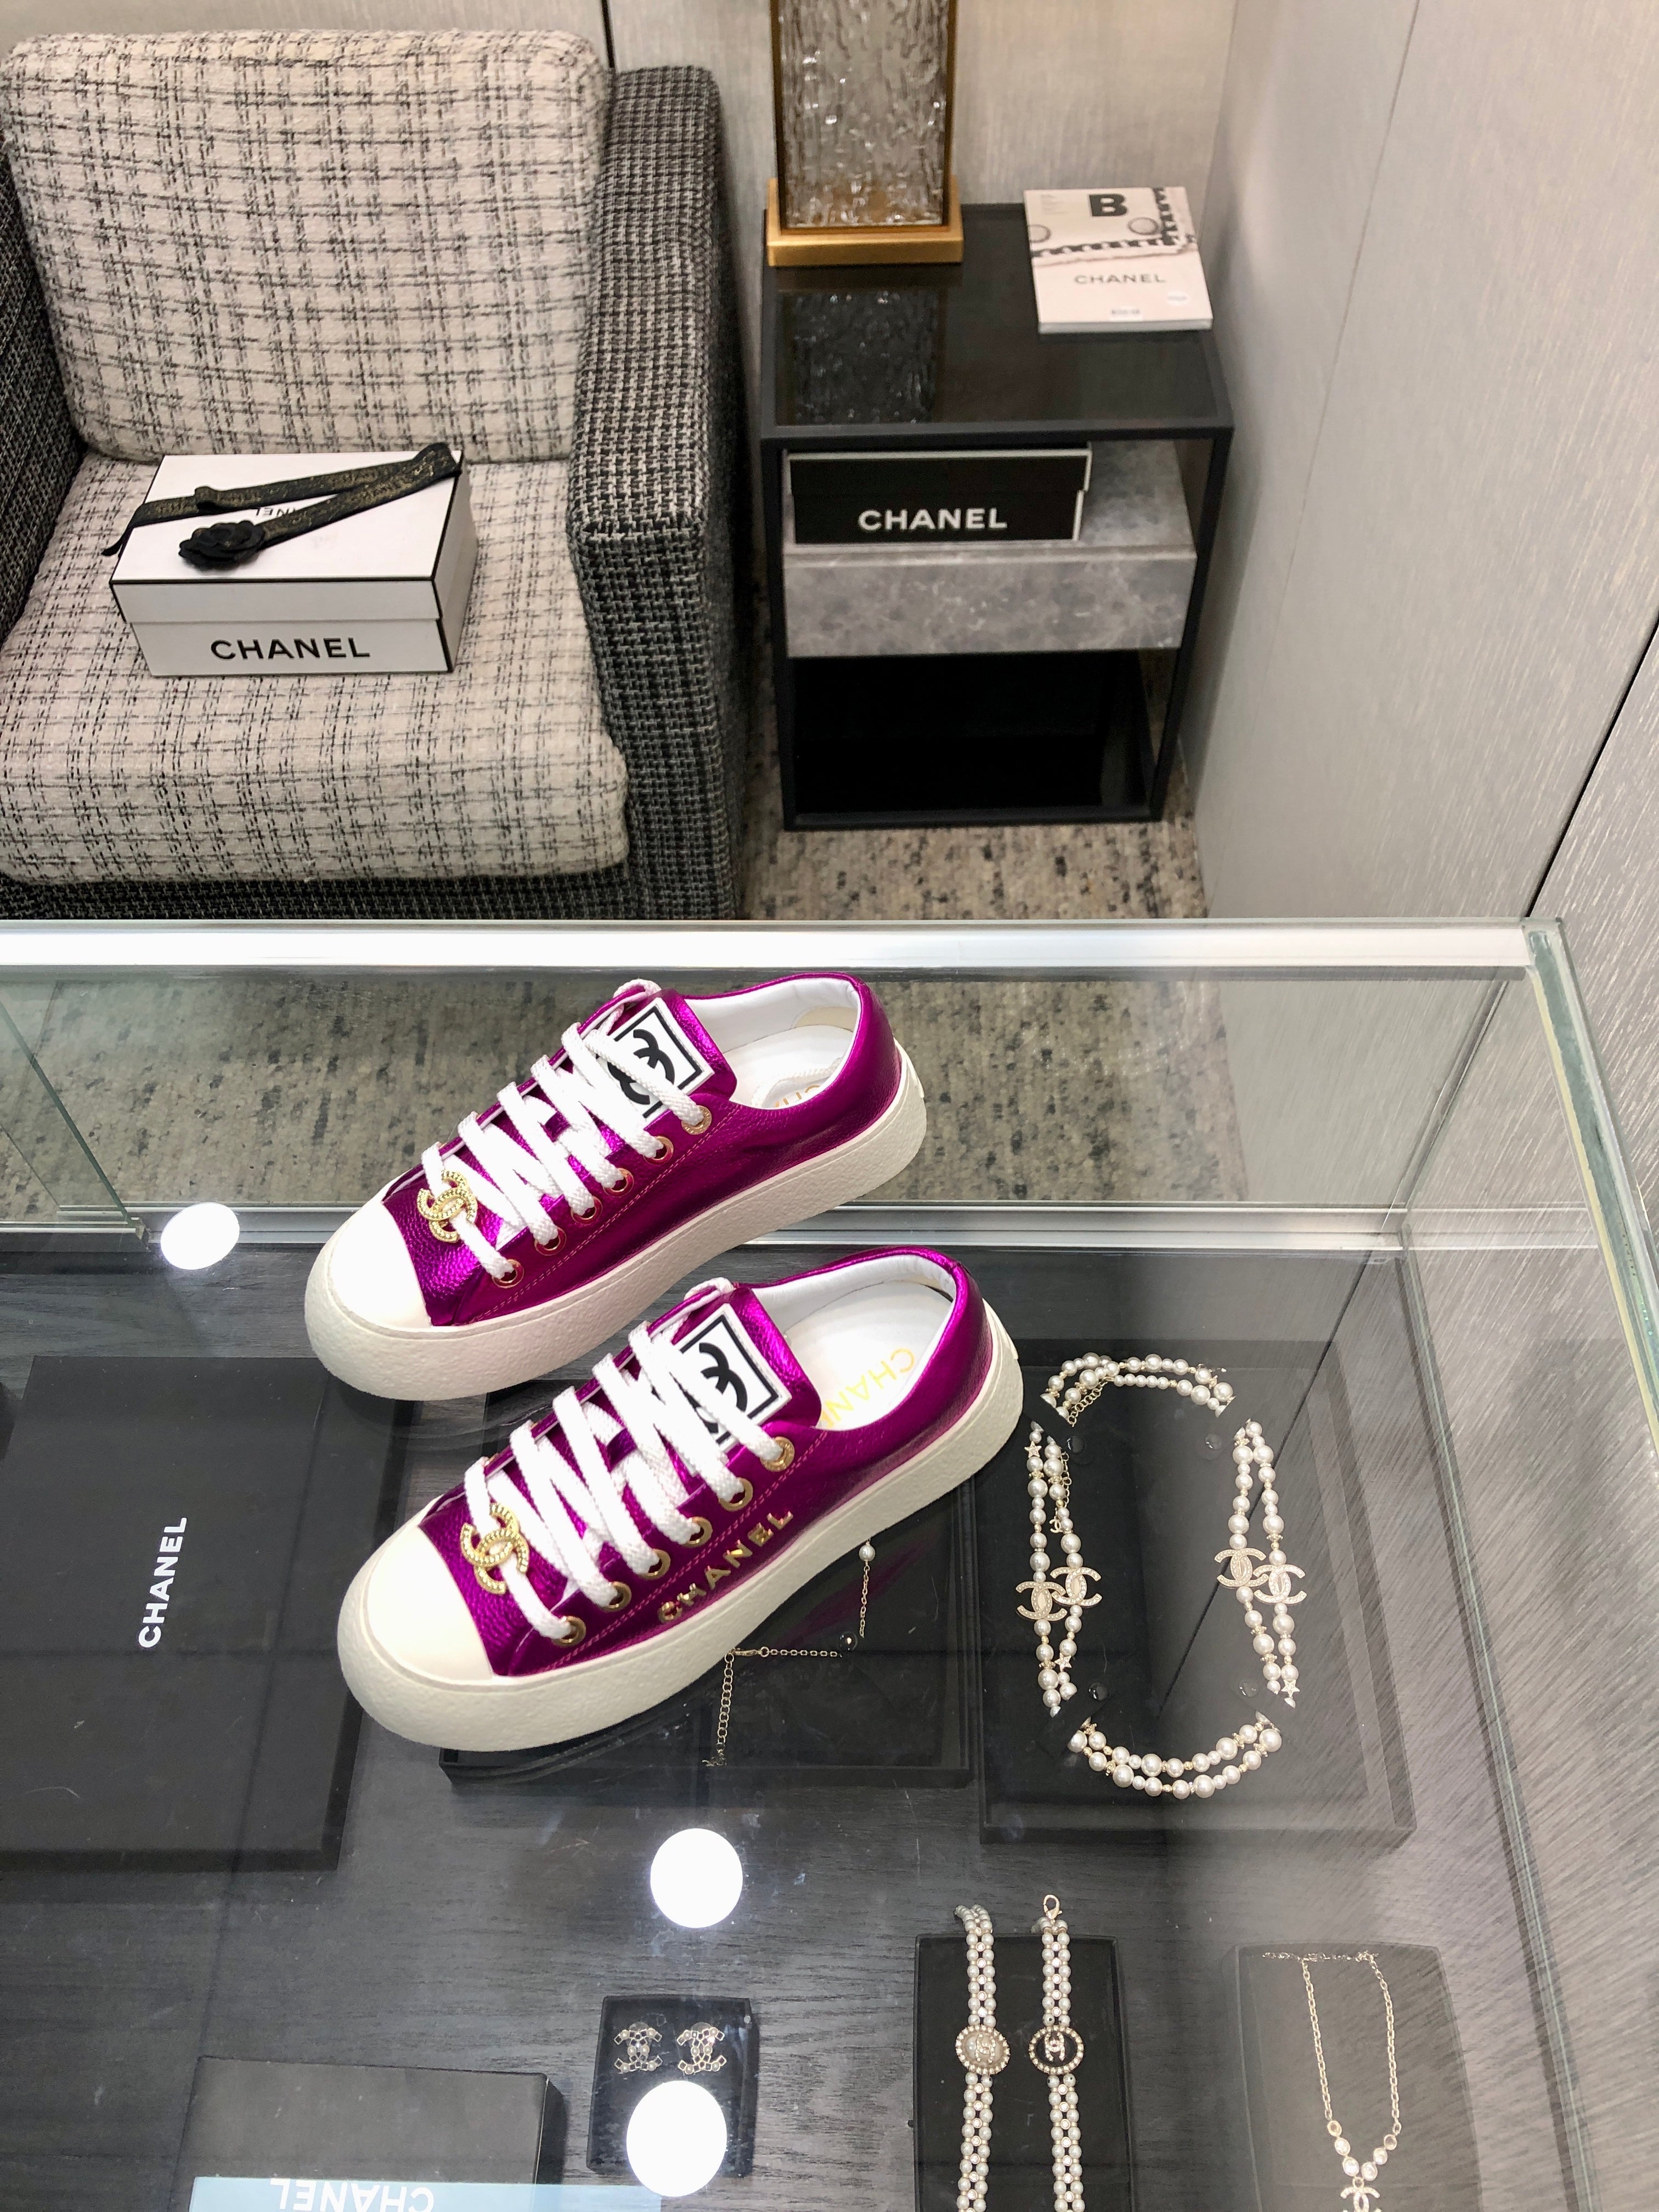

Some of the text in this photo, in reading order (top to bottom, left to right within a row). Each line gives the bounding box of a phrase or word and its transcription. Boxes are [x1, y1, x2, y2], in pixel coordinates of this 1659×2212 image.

[1088, 194, 1128, 217] B
[1074, 272, 1166, 285] CHANEL
[859, 508, 1008, 531] CHANEL
[211, 637, 371, 660] CHANEL
[658, 1511, 794, 1623] CHANEL
[138, 1517, 188, 1648] CHANEL
[270, 2178, 435, 2212] CHANEL
